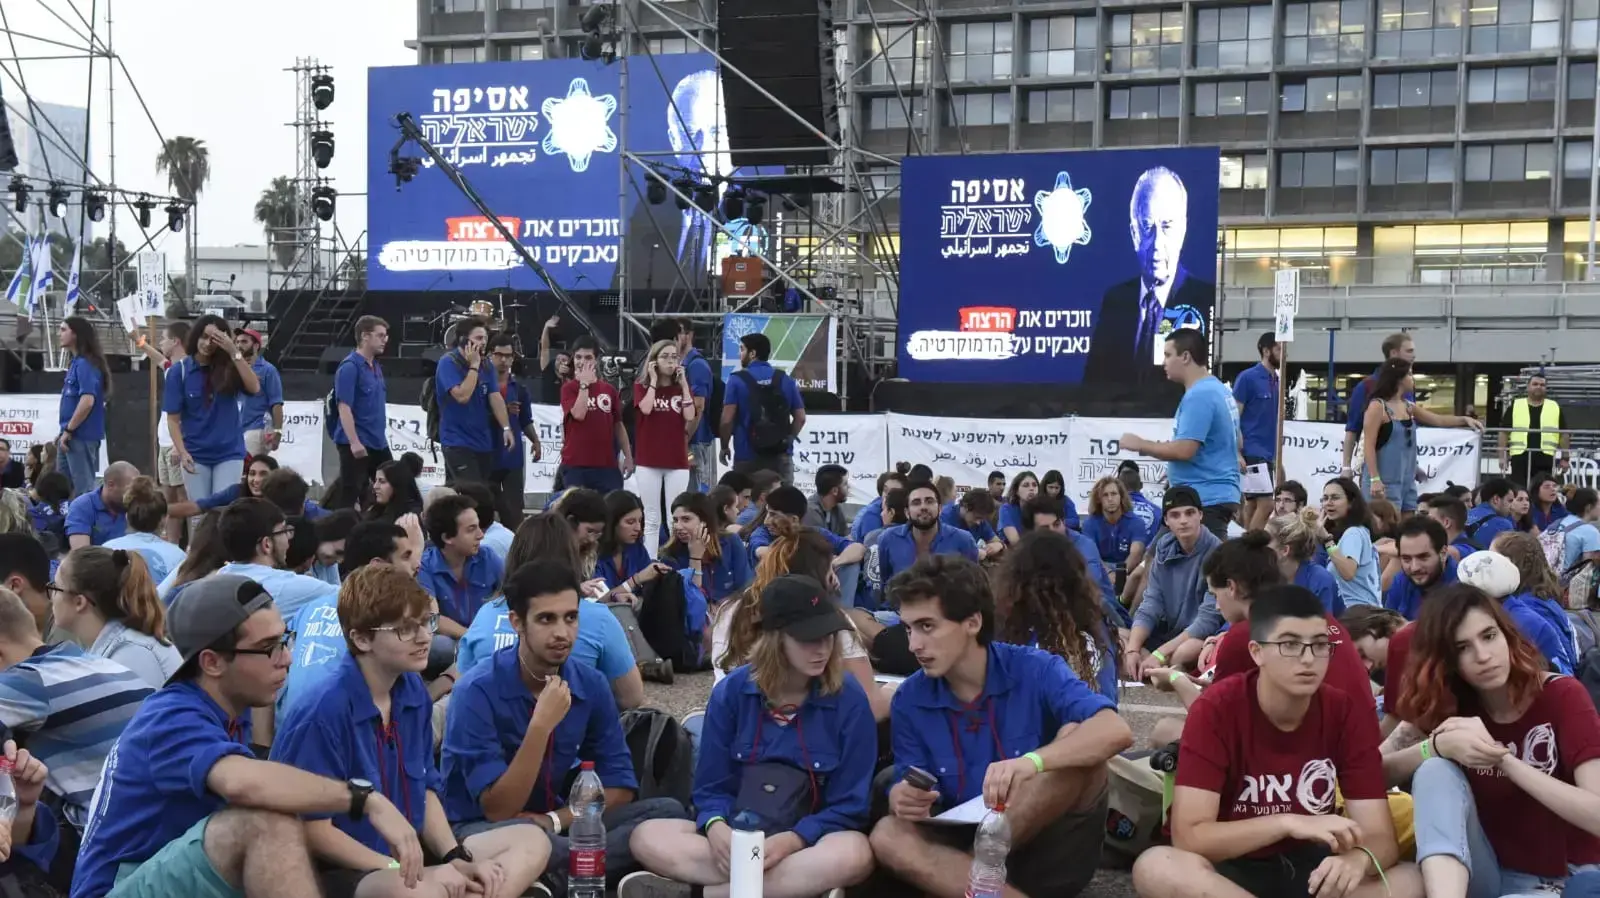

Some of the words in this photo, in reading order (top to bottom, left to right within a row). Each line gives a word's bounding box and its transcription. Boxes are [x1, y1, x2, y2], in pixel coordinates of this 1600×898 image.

[432, 86, 529, 112] אסיפה
[421, 114, 539, 146] ישראלית
[491, 148, 537, 167] تجمهر
[951, 178, 1025, 203] אסיפה
[523, 219, 554, 238] את
[559, 218, 620, 238] זוכרים
[940, 206, 1032, 237] ישראלית
[390, 247, 505, 267] הדמוקרטיה.
[546, 245, 619, 269] נאבקים
[994, 240, 1030, 258] تجمهر
[965, 312, 1012, 329] הרצח.
[1018, 310, 1041, 328] את
[1045, 310, 1092, 328] זוכרים
[914, 337, 1004, 357] הדמוקרטיה.
[1035, 336, 1090, 358] נאבקים
[810, 430, 849, 445] חביב
[901, 427, 942, 441] לשנות
[947, 430, 1005, 444] להשפיע,
[1011, 431, 1068, 446] להיפגש,
[1283, 434, 1330, 449] לשנות
[800, 450, 855, 465] שנברא
[1251, 805, 1270, 815] נוער
